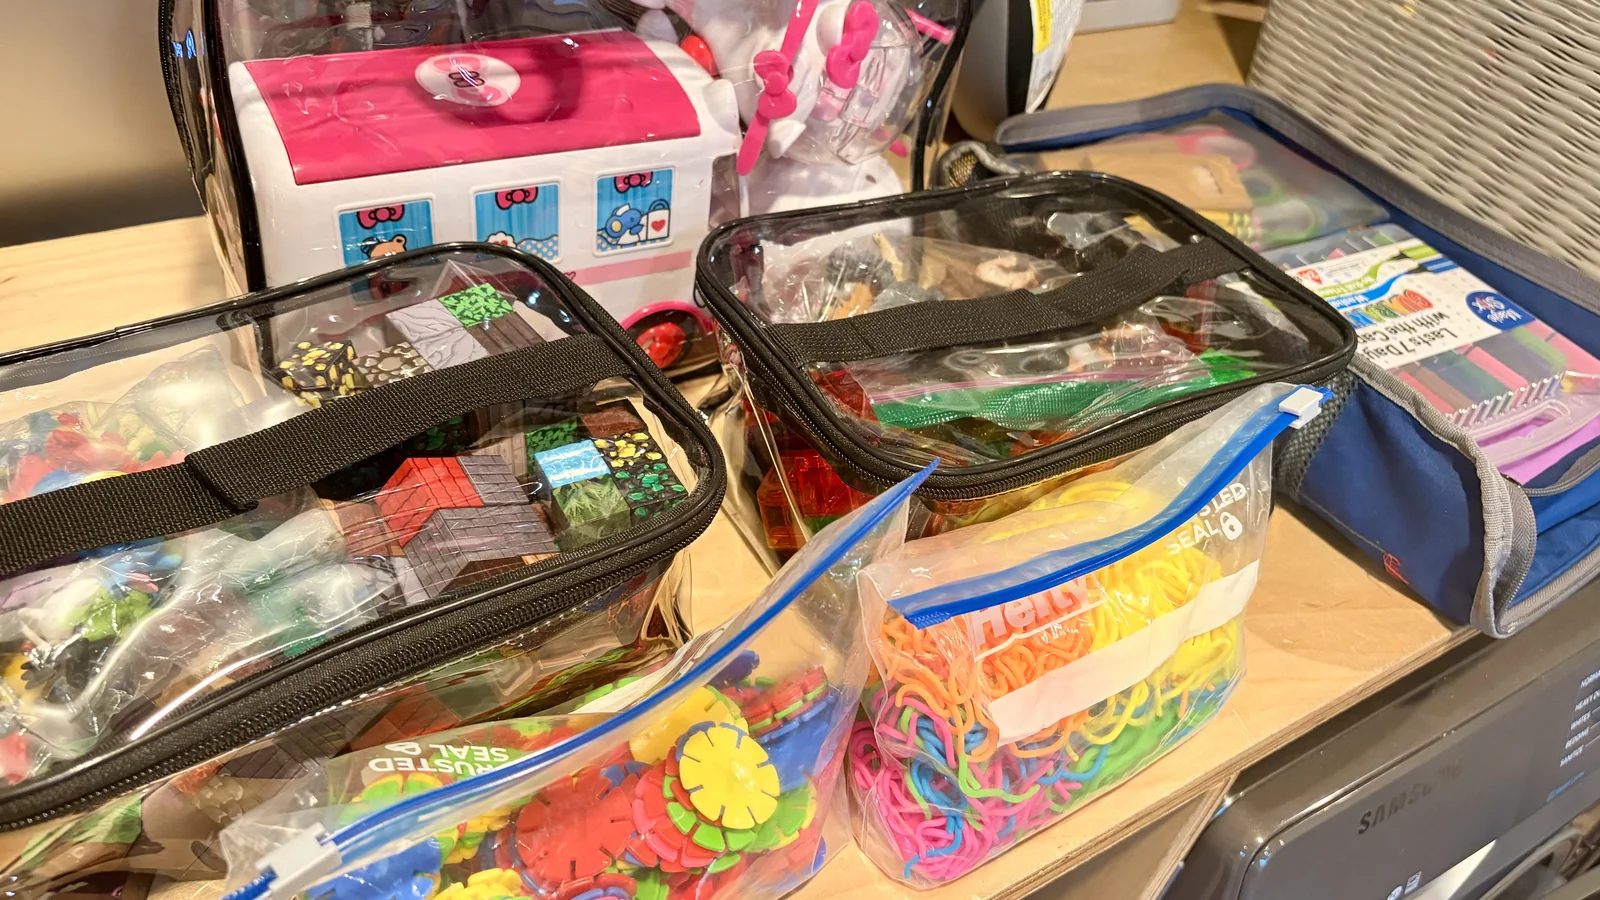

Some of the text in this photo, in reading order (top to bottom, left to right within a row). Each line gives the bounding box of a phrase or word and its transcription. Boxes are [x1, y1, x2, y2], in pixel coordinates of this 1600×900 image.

[1386, 320, 1410, 335] the
[1409, 311, 1451, 331] with
[1362, 326, 1459, 361] Lasts 7 Day
[1165, 518, 1220, 556] SEAL
[428, 743, 510, 762] SEAL
[368, 757, 495, 776] RUSTED
